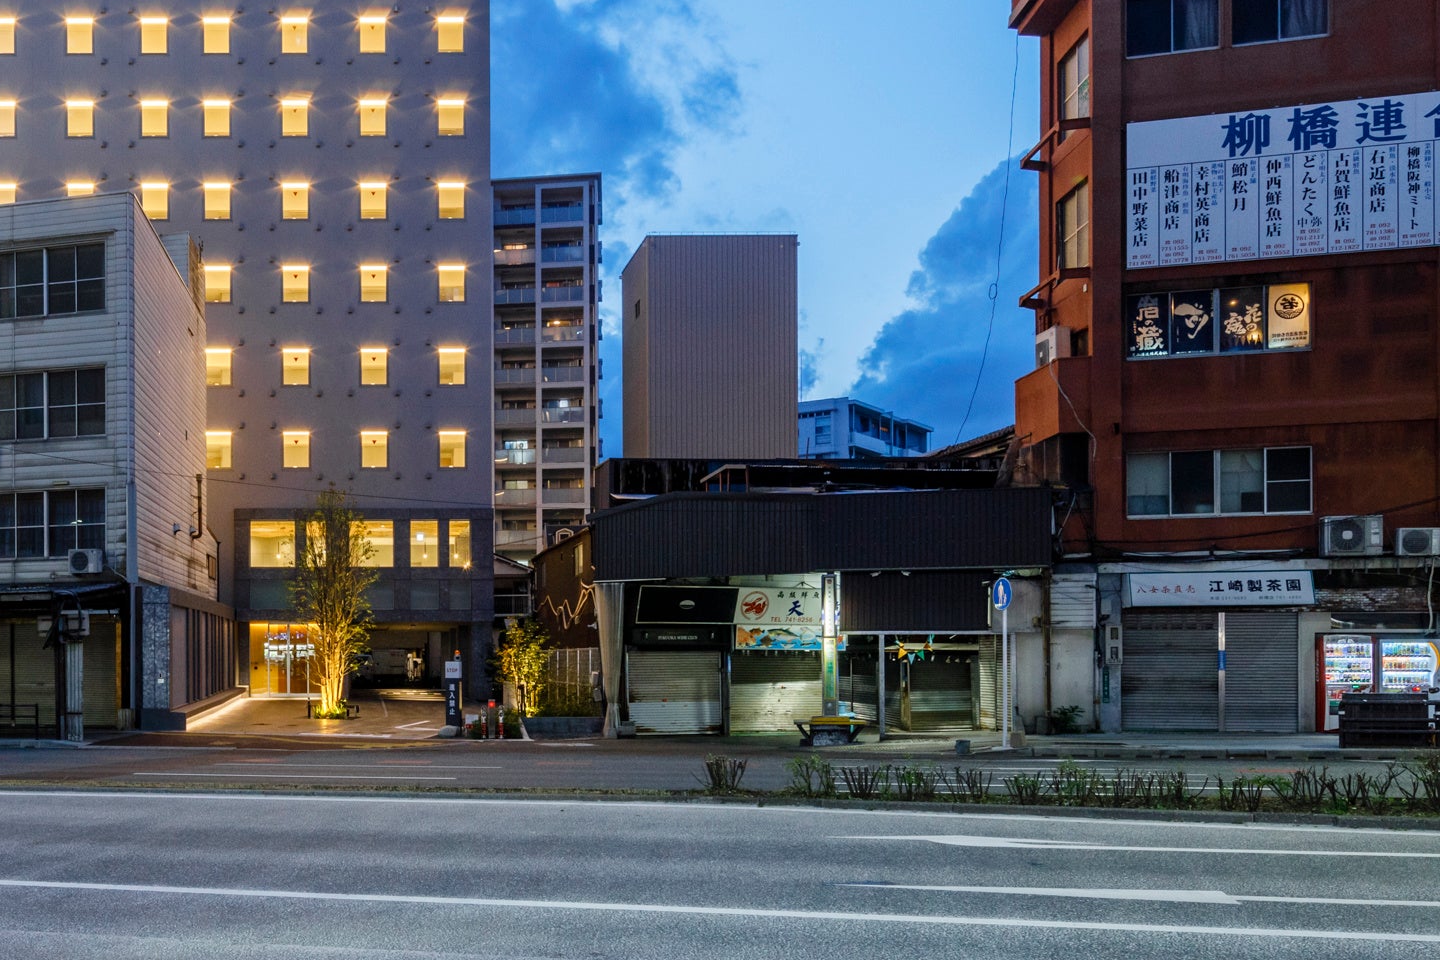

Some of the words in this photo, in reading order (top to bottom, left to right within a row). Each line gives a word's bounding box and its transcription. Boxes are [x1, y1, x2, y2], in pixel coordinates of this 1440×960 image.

[1132, 172, 1148, 247] 田中野菜店
[1163, 169, 1180, 230] 船津商店
[1194, 166, 1210, 243] 幸村英商店
[1265, 159, 1282, 237] 仲西鮮魚店
[1301, 154, 1317, 216] どんたく
[1334, 153, 1350, 232] 古賀鮮魚店
[1369, 150, 1386, 213] 右近商店
[1407, 146, 1420, 230] 柳橋阪神ミート
